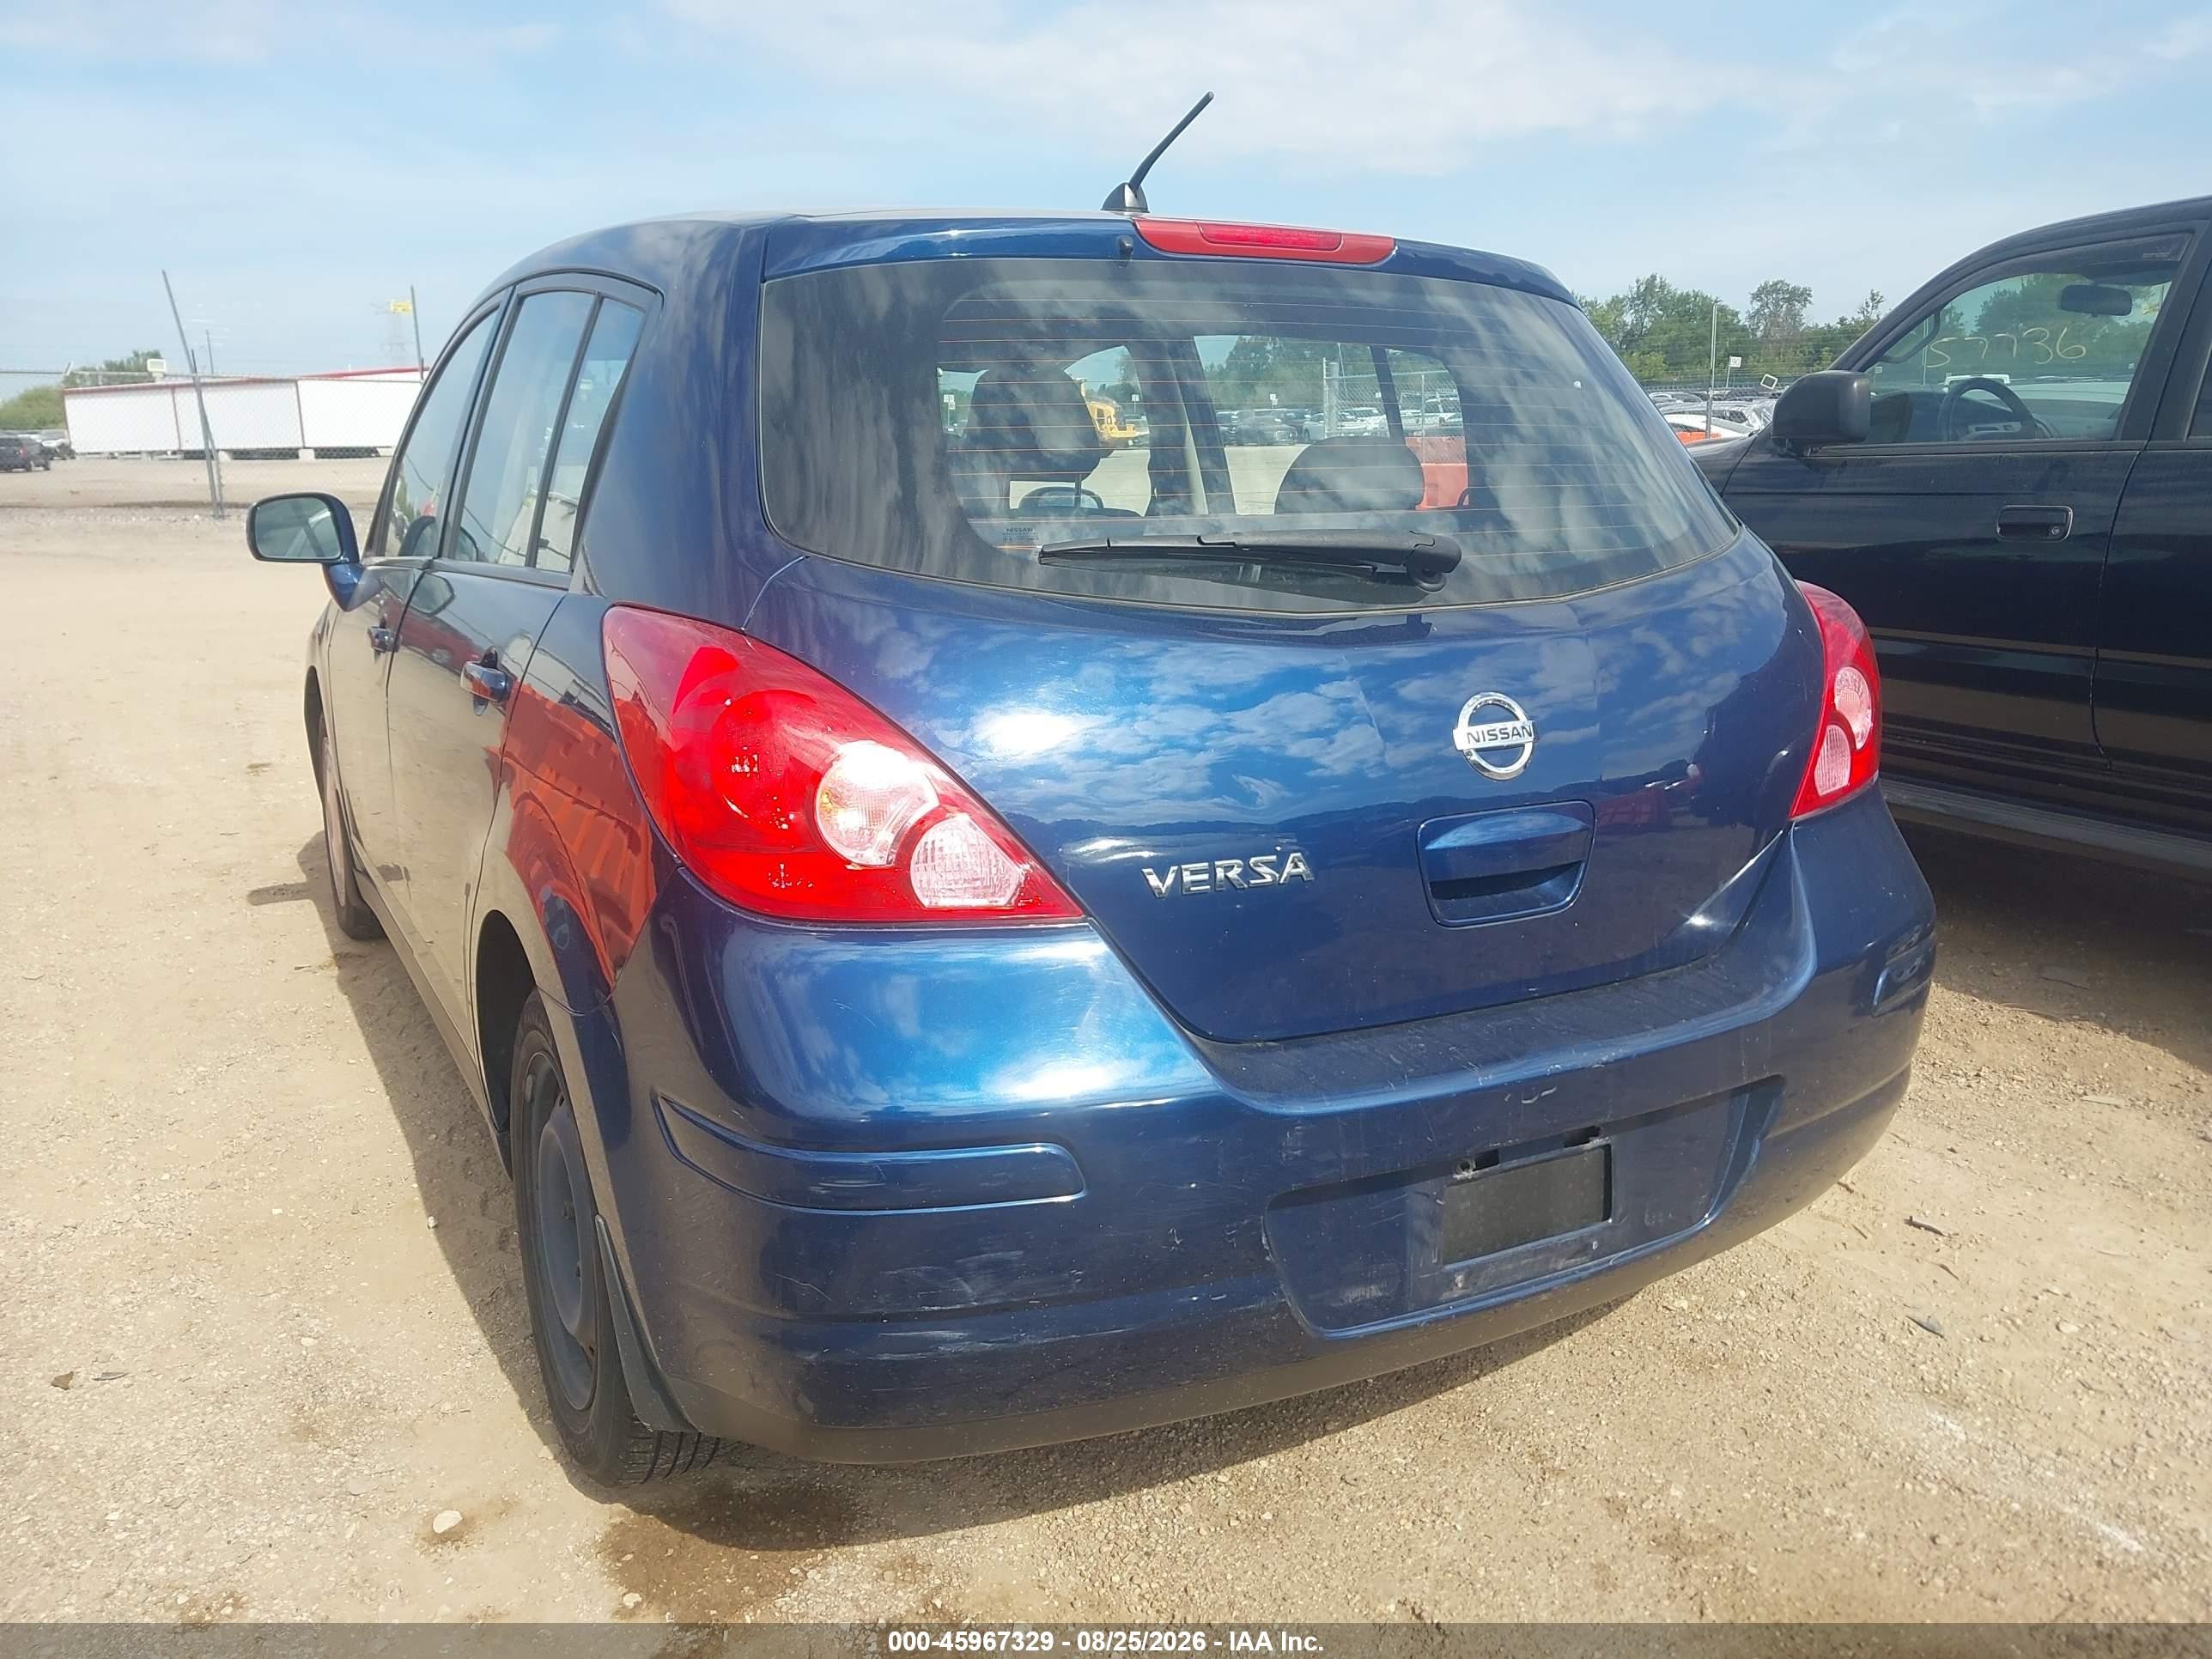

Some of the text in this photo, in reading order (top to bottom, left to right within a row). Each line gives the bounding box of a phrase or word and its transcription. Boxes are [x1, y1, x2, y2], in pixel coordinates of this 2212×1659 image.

[1926, 326, 2087, 368] 57736
[1467, 725, 1533, 744] NISSAN
[1141, 852, 1315, 898] VERSA
